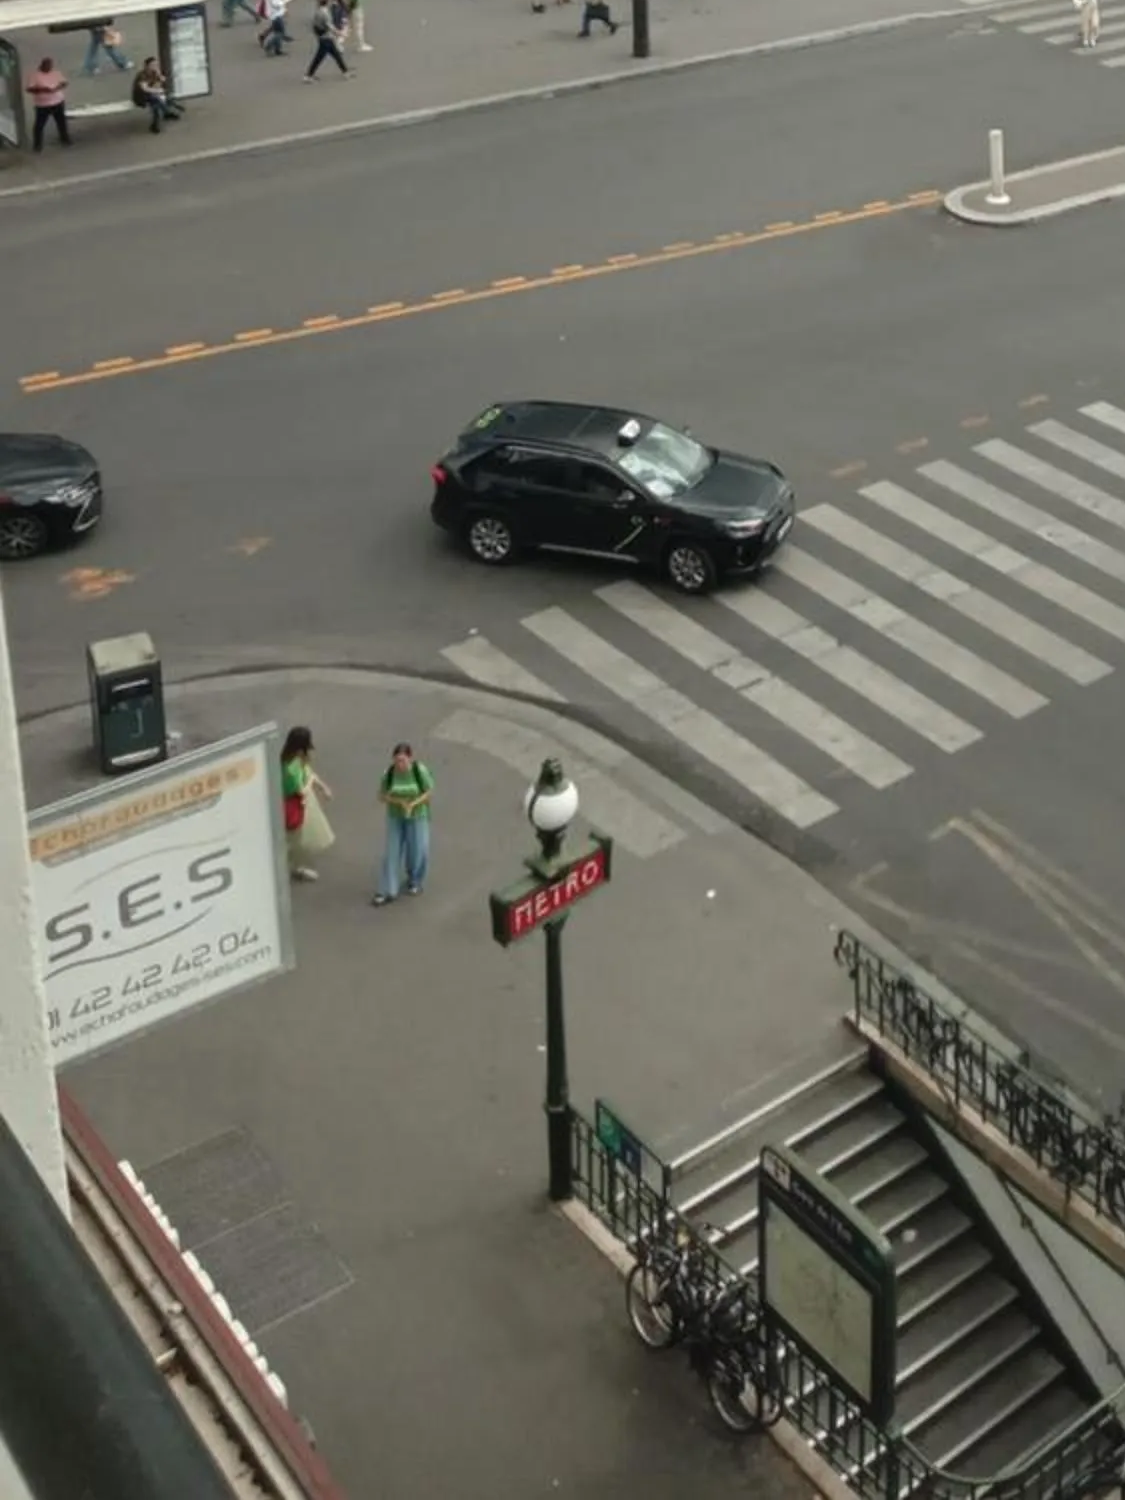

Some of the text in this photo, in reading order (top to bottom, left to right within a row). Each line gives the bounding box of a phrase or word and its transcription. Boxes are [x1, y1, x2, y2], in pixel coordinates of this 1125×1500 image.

[514, 859, 599, 933] METRO
[69, 985, 113, 1019] 42
[121, 963, 163, 997] 42
[171, 943, 213, 975] 42
[219, 924, 260, 956] 04
